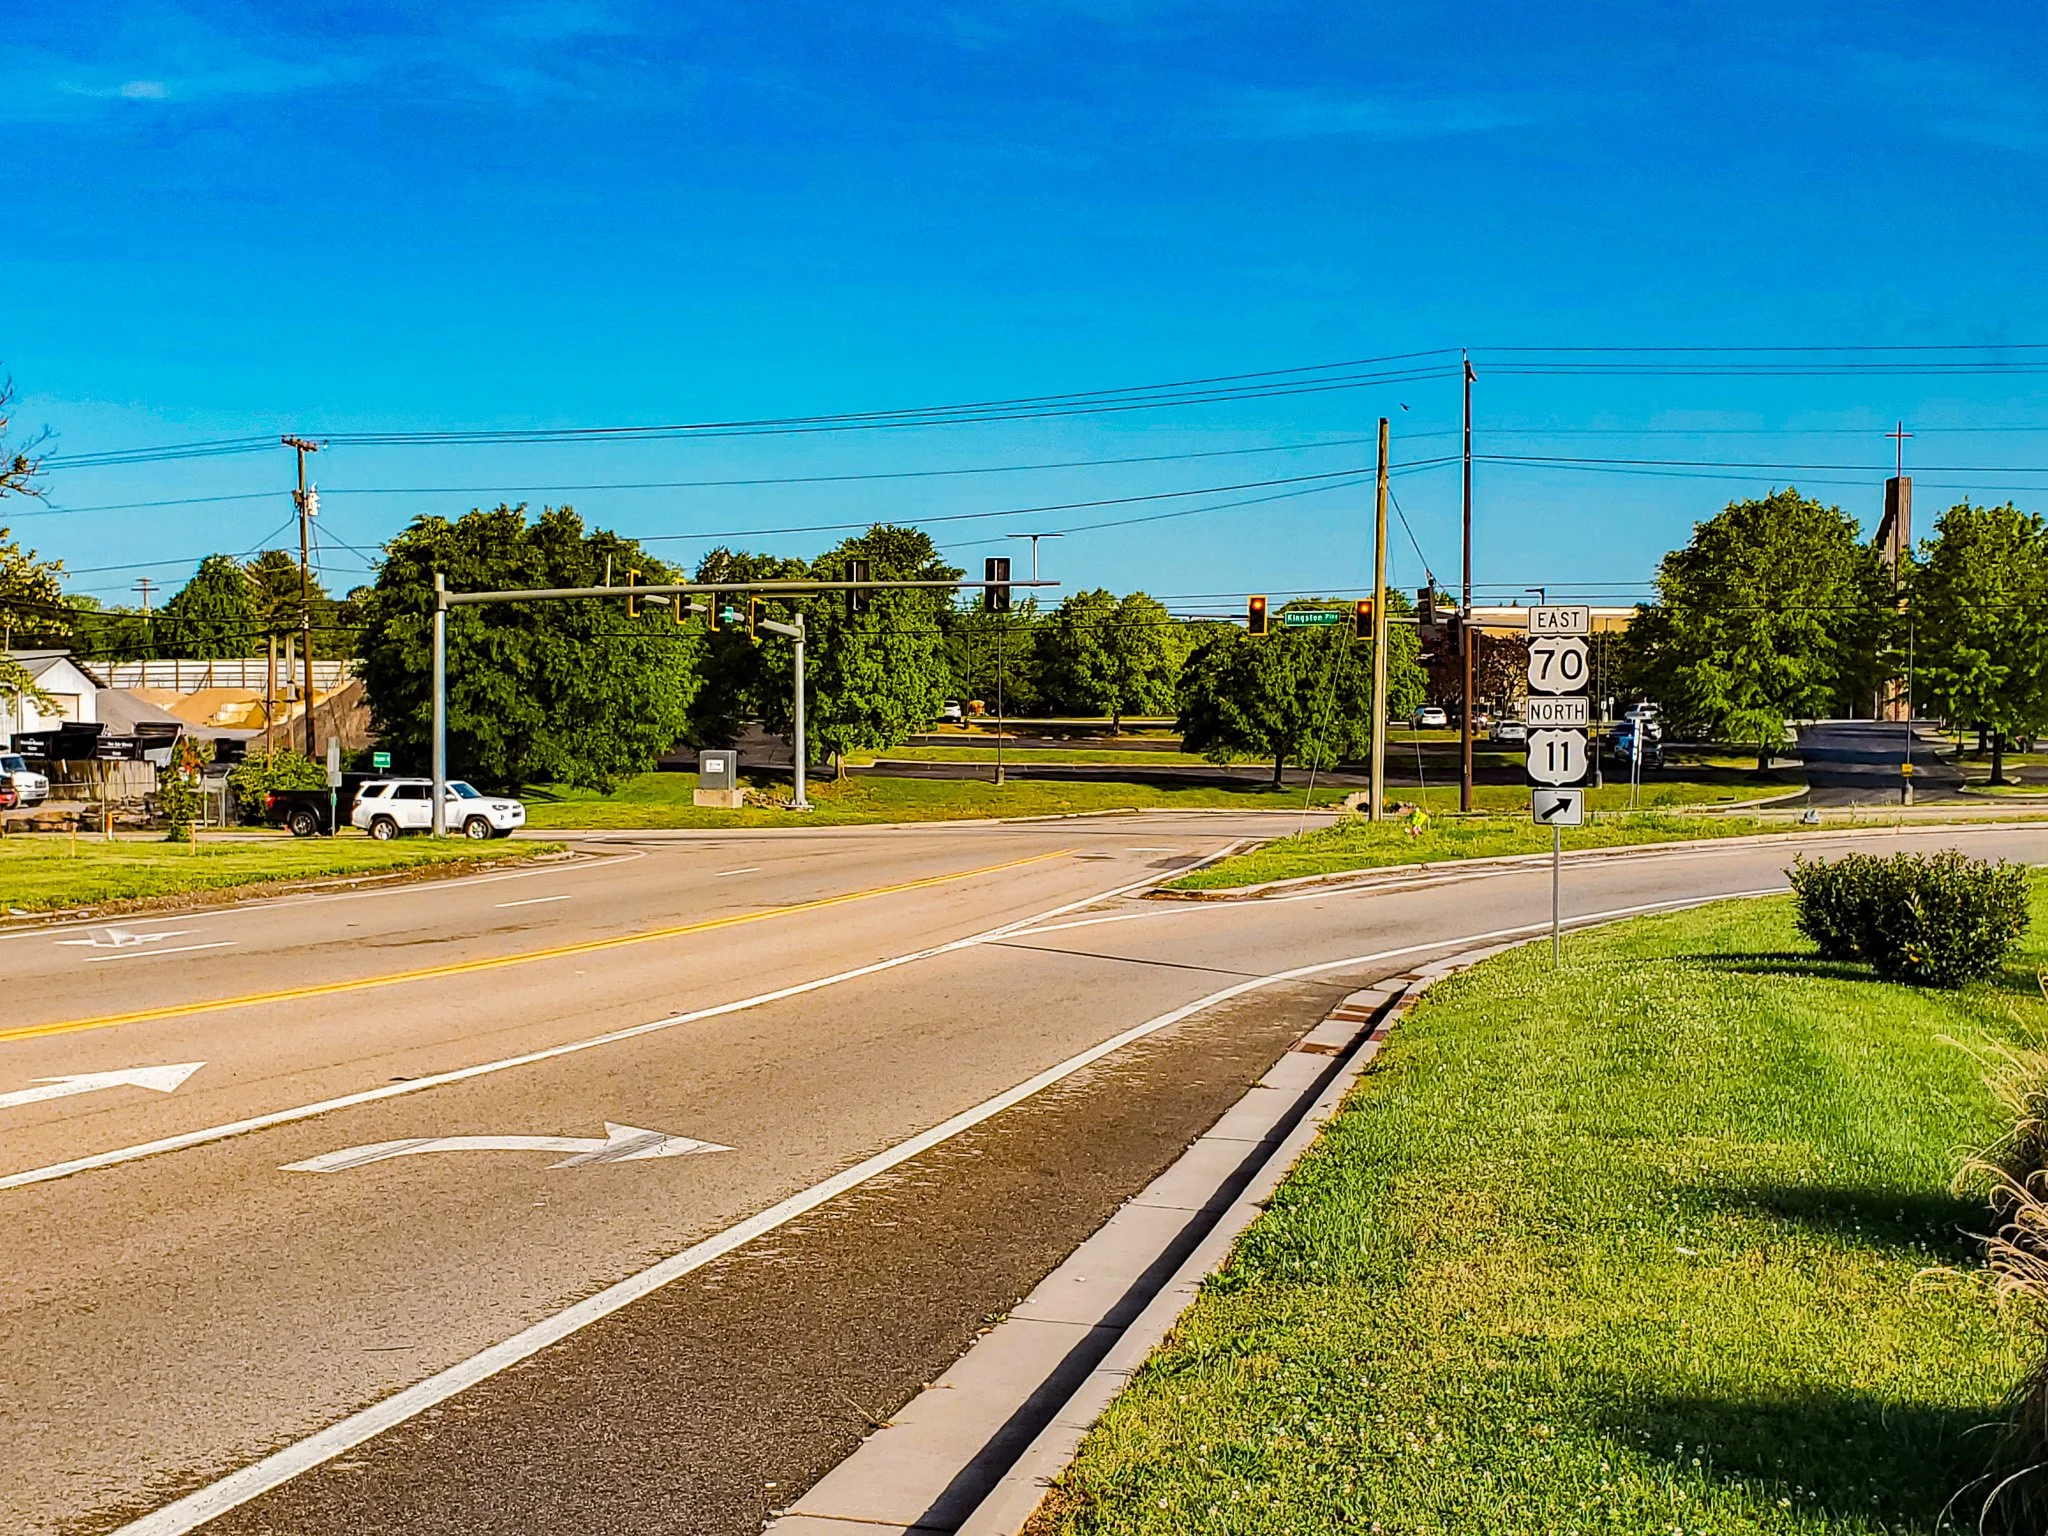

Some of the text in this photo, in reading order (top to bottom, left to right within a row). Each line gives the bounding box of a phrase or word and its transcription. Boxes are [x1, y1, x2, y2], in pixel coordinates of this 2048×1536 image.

[1287, 614, 1323, 623] Kingston
[1538, 612, 1580, 628] EAST
[1534, 649, 1583, 680] 70
[1531, 704, 1585, 720] NORTH
[1546, 741, 1569, 772] 11
